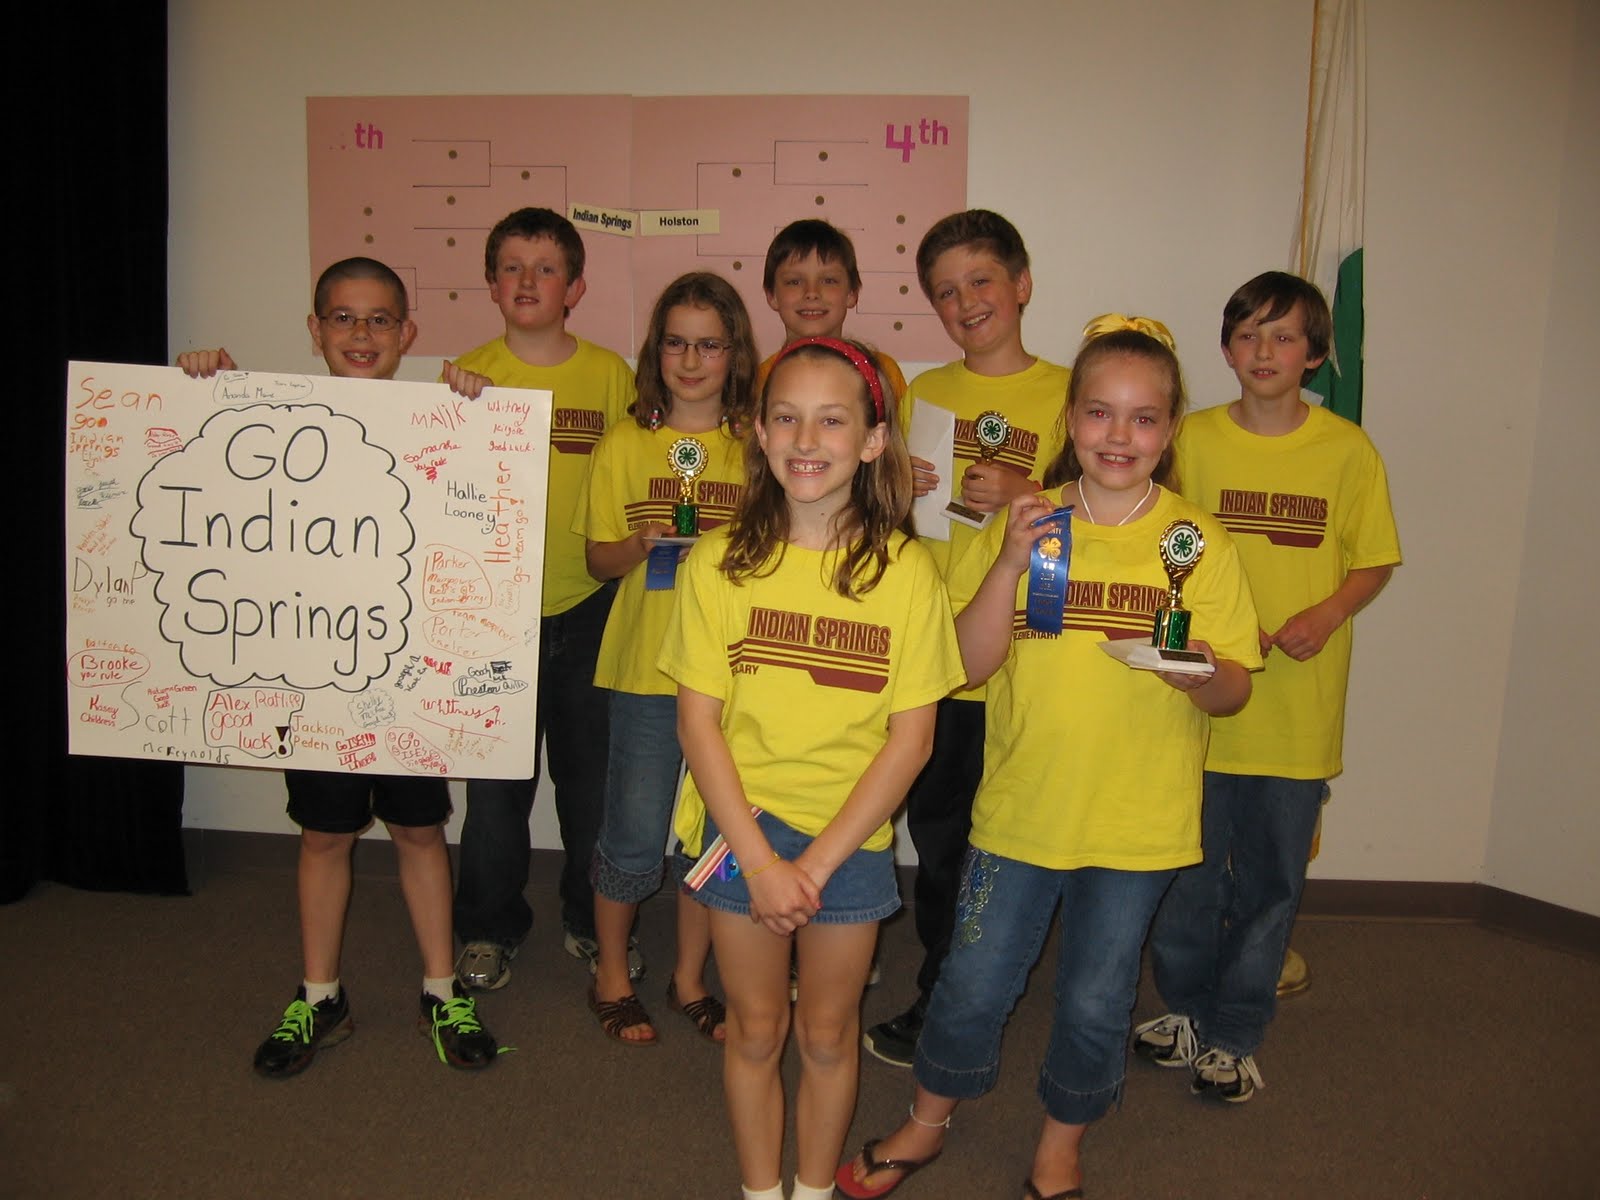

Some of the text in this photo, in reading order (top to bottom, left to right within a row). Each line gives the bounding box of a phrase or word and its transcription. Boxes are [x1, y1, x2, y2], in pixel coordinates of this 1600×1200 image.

[885, 118, 949, 163] 4th
[572, 207, 632, 231] Indian Springs
[659, 216, 699, 226] Holston
[75, 377, 162, 411] Sean
[555, 408, 604, 431] SPRINGS
[225, 423, 328, 482] GO
[447, 480, 488, 502] Hallie
[1220, 489, 1328, 521] INDIAN SPRINGS
[158, 485, 379, 558] Indian
[444, 501, 496, 535] Looney
[484, 461, 512, 565] Heather
[431, 551, 471, 572] Parker
[184, 568, 388, 676] Springs
[747, 607, 891, 657] INDIAN SPRINGS
[80, 654, 144, 670] Brooke
[208, 692, 250, 712] Alex
[210, 711, 253, 742] good
[291, 714, 345, 737] Jackson
[293, 735, 330, 751] Peden
